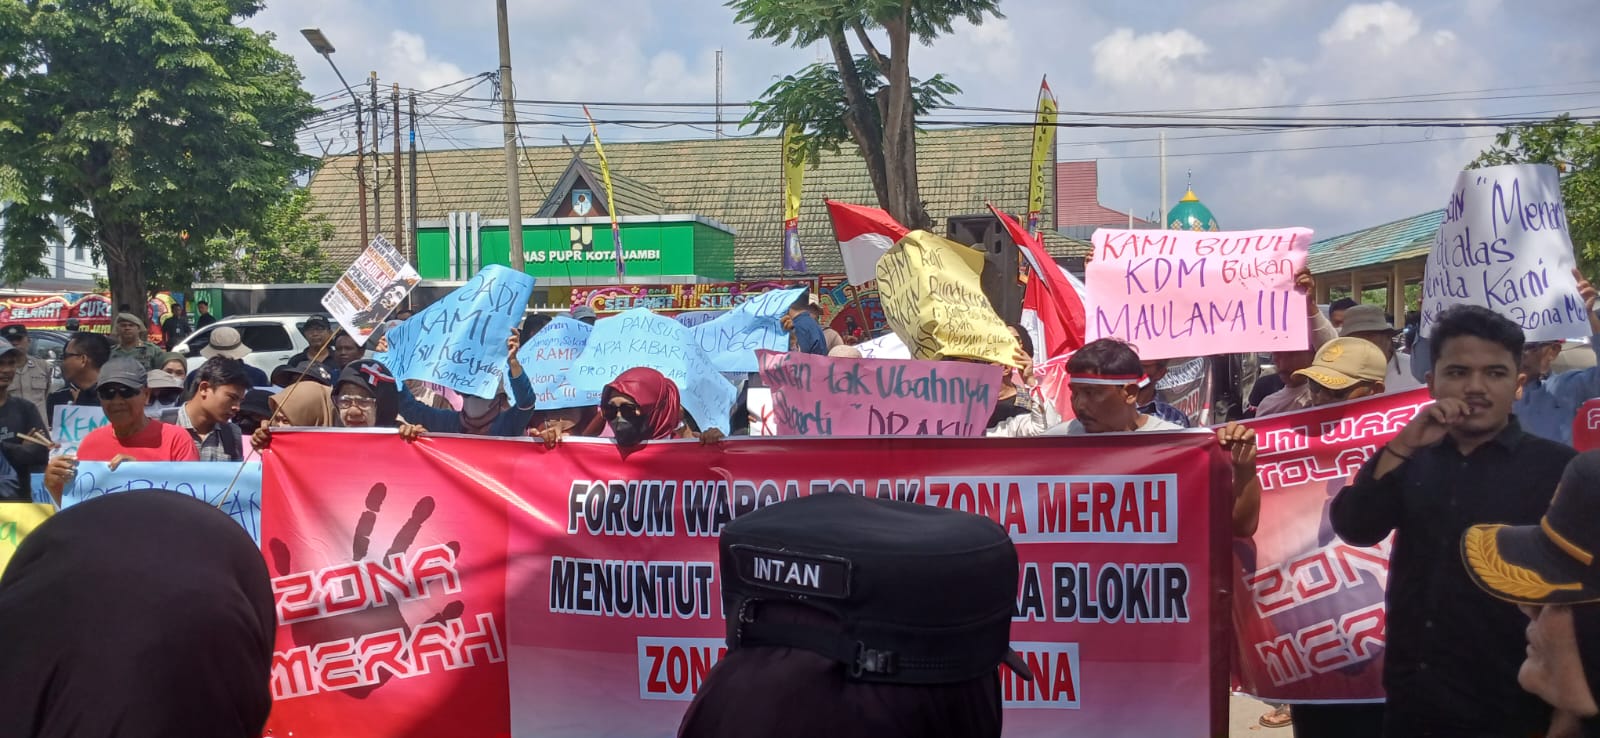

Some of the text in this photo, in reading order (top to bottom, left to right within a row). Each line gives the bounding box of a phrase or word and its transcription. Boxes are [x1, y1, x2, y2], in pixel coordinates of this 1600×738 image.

[509, 250, 660, 262] NAS PUPR KOTA JAMBI
[1102, 233, 1297, 261] KAMI BUTUH
[458, 273, 519, 316] JADI
[1126, 257, 1206, 295] KDM
[10, 301, 112, 320] SELAMAT SUKS
[605, 294, 752, 310] SELAMAT SUKS
[1096, 300, 1247, 342] MAULANA
[619, 315, 682, 342] PANSUS
[824, 361, 873, 396] tak
[875, 365, 989, 425] Ubahnya
[567, 479, 676, 536] FORUM
[1036, 480, 1168, 534] MERAH
[271, 543, 462, 625] ZONA
[549, 556, 714, 619] MENUNTUT
[1052, 562, 1190, 623] BLOKIR
[753, 556, 820, 588] INTAN
[1242, 530, 1398, 619] ZON
[270, 612, 505, 700] MERAH
[1254, 602, 1385, 687] MER
